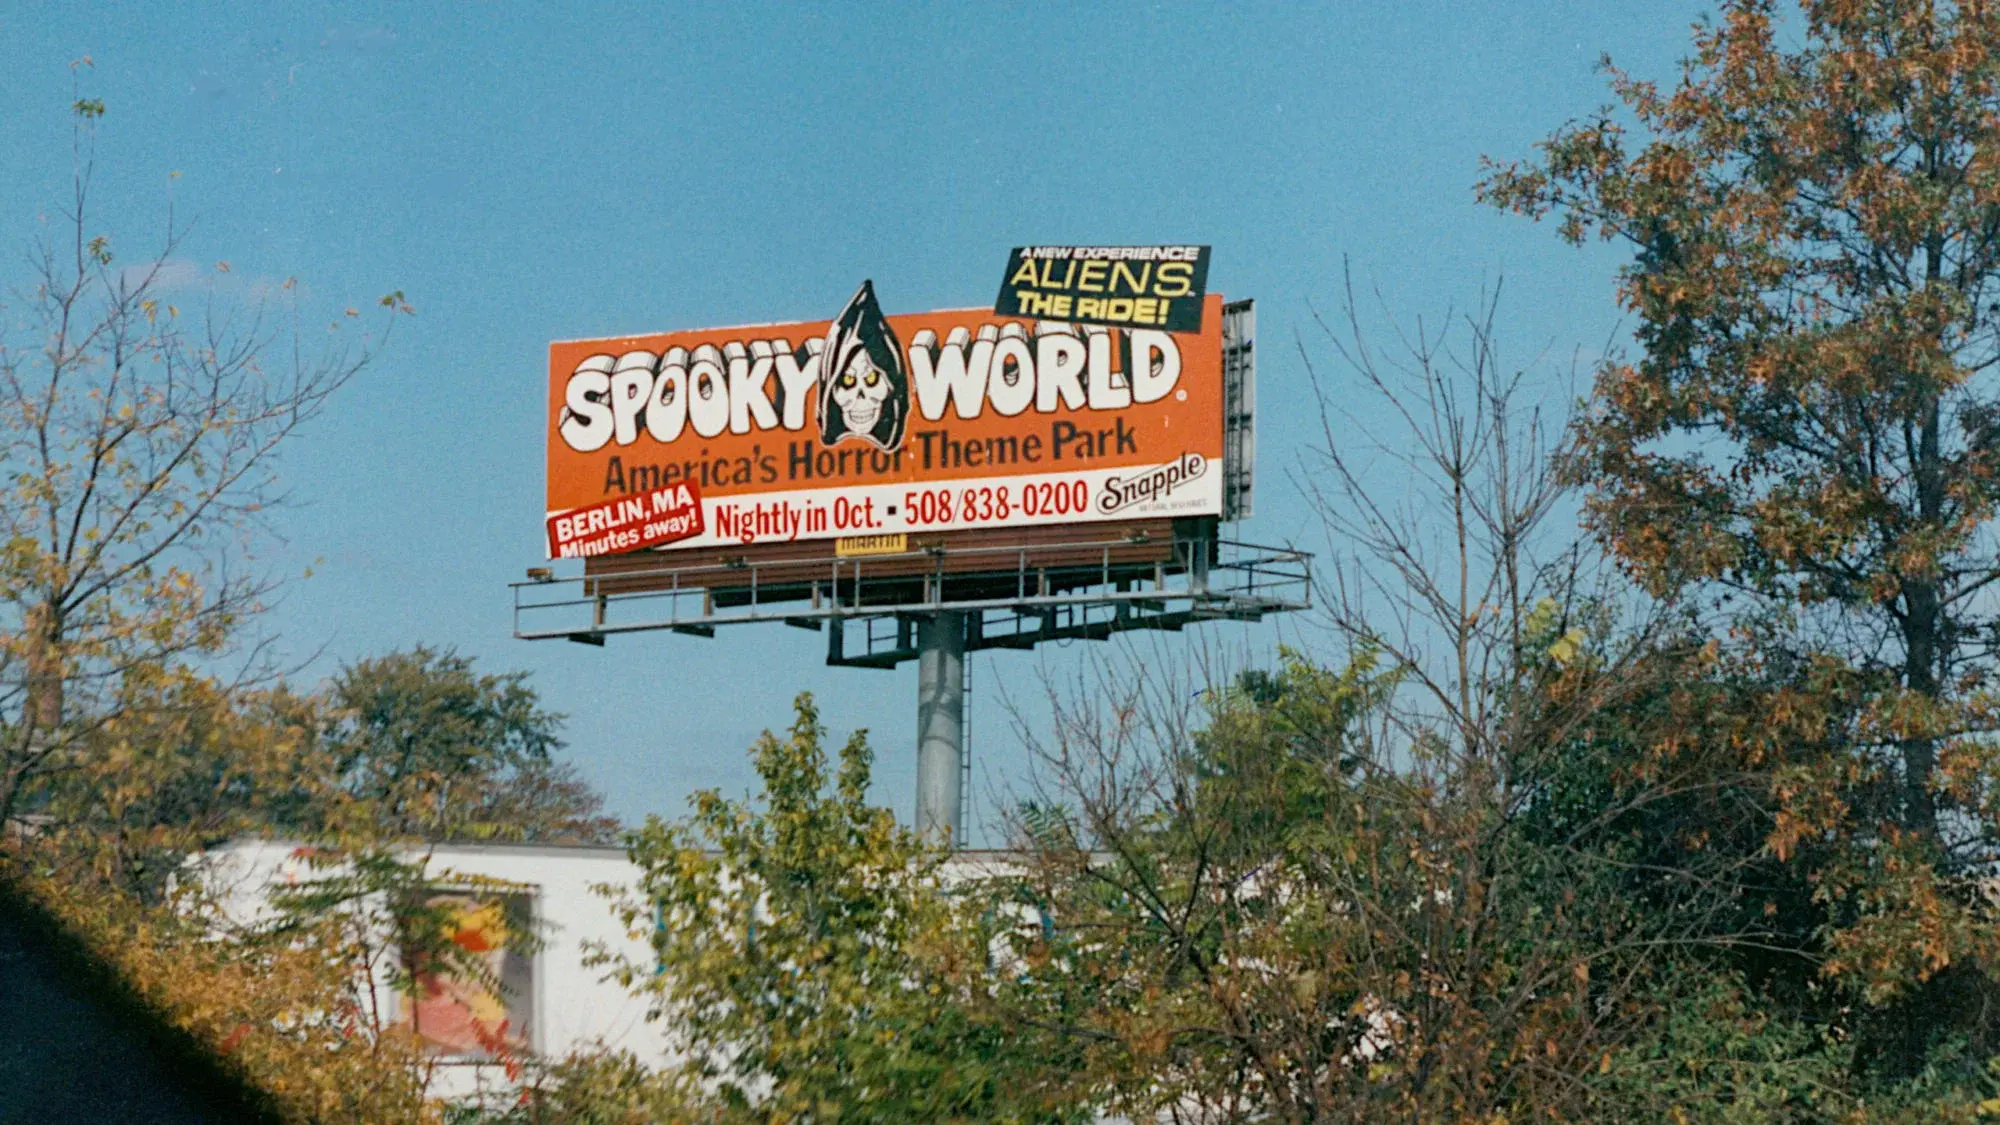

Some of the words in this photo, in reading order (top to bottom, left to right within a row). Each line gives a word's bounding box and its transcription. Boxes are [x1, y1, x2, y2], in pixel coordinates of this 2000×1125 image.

[1010, 258, 1195, 297] ALIENS
[1033, 246, 1072, 260] NEW
[1073, 246, 1199, 261] EXPERIENCE
[1016, 290, 1073, 316] THE
[1075, 298, 1171, 325] RIDE!
[559, 338, 826, 453] SPOOKY
[908, 320, 1182, 421] WORLD
[604, 443, 778, 495] America's
[788, 440, 908, 480] Horror
[916, 429, 1042, 470] Theme
[1053, 416, 1137, 460] Park
[1101, 451, 1201, 510] Snapple
[556, 497, 652, 542] BERLIN,
[652, 484, 694, 514] MA
[559, 528, 641, 559] Minutes
[643, 507, 697, 540] away!
[716, 500, 801, 545] Nightly
[806, 499, 826, 532] in
[834, 496, 882, 530] Oct.
[904, 479, 1088, 525] 508/838-0200
